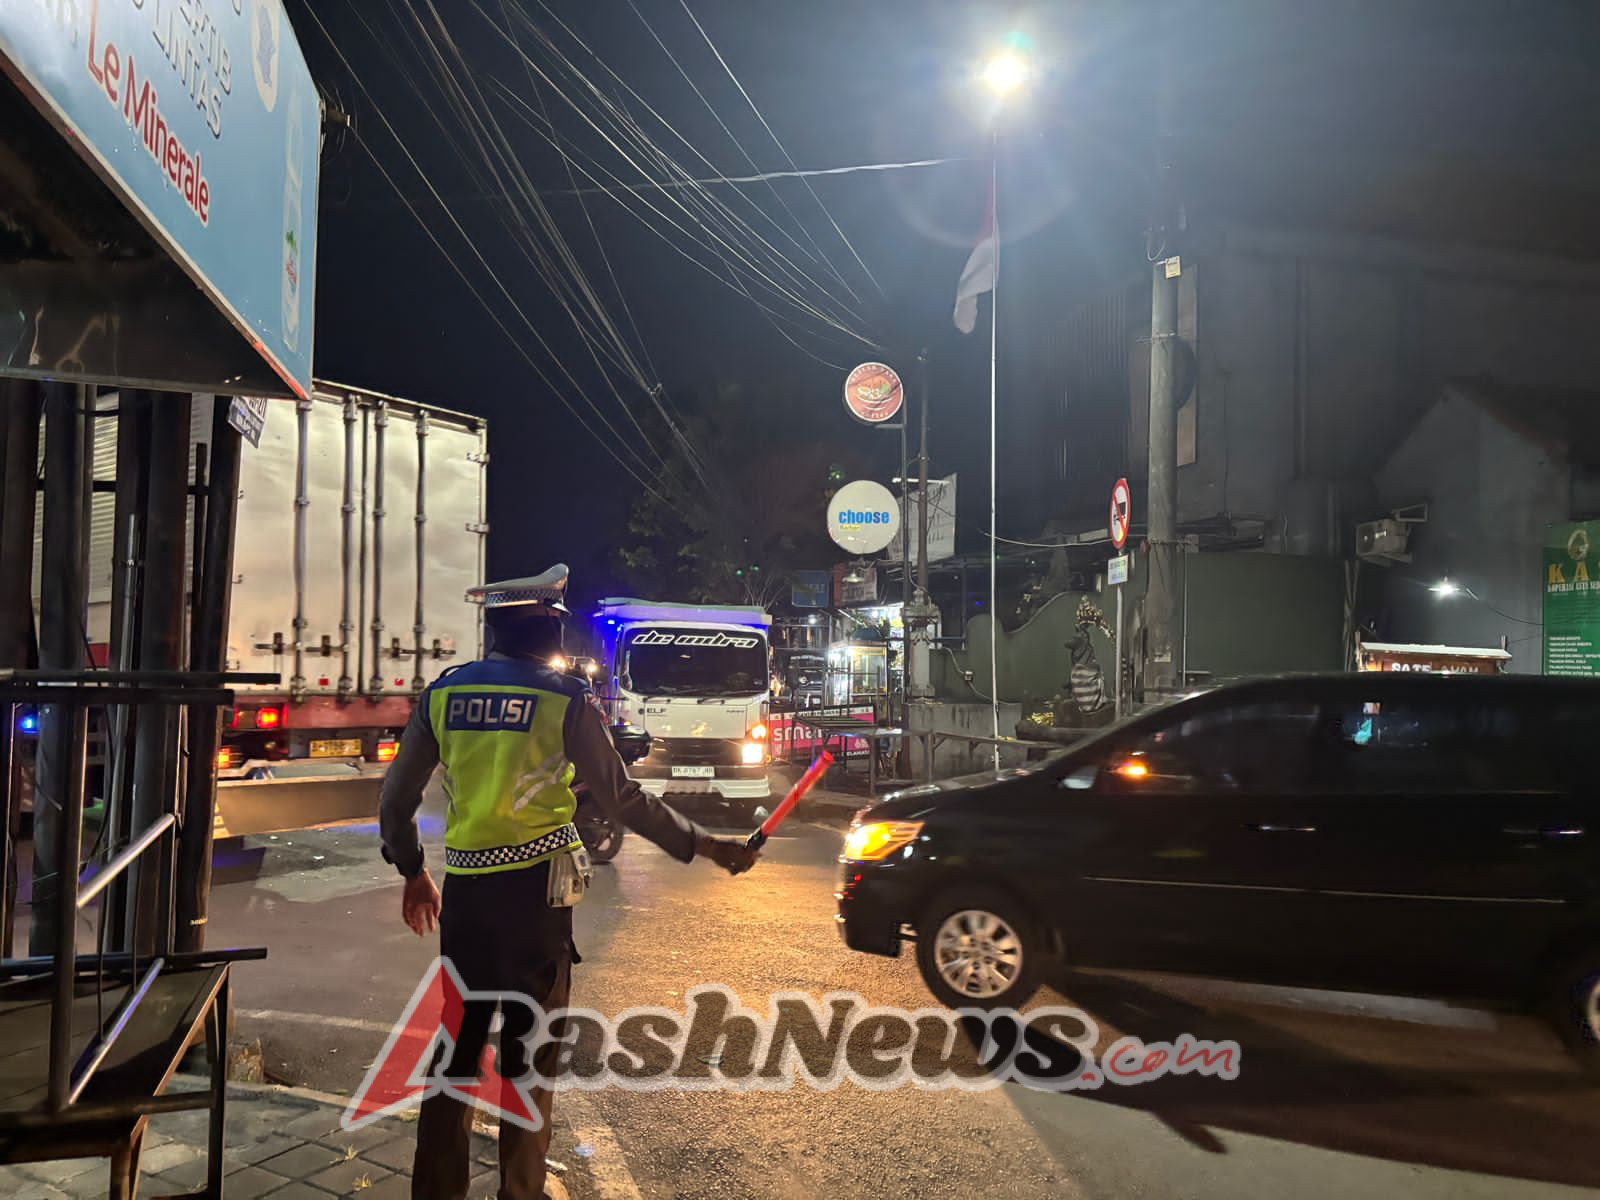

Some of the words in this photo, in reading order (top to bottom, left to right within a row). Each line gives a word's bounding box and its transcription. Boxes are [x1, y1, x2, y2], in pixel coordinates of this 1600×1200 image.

[88, 0, 120, 103] Le
[124, 56, 208, 223] Minerale
[838, 508, 890, 525] choose
[448, 698, 532, 724] POLISI
